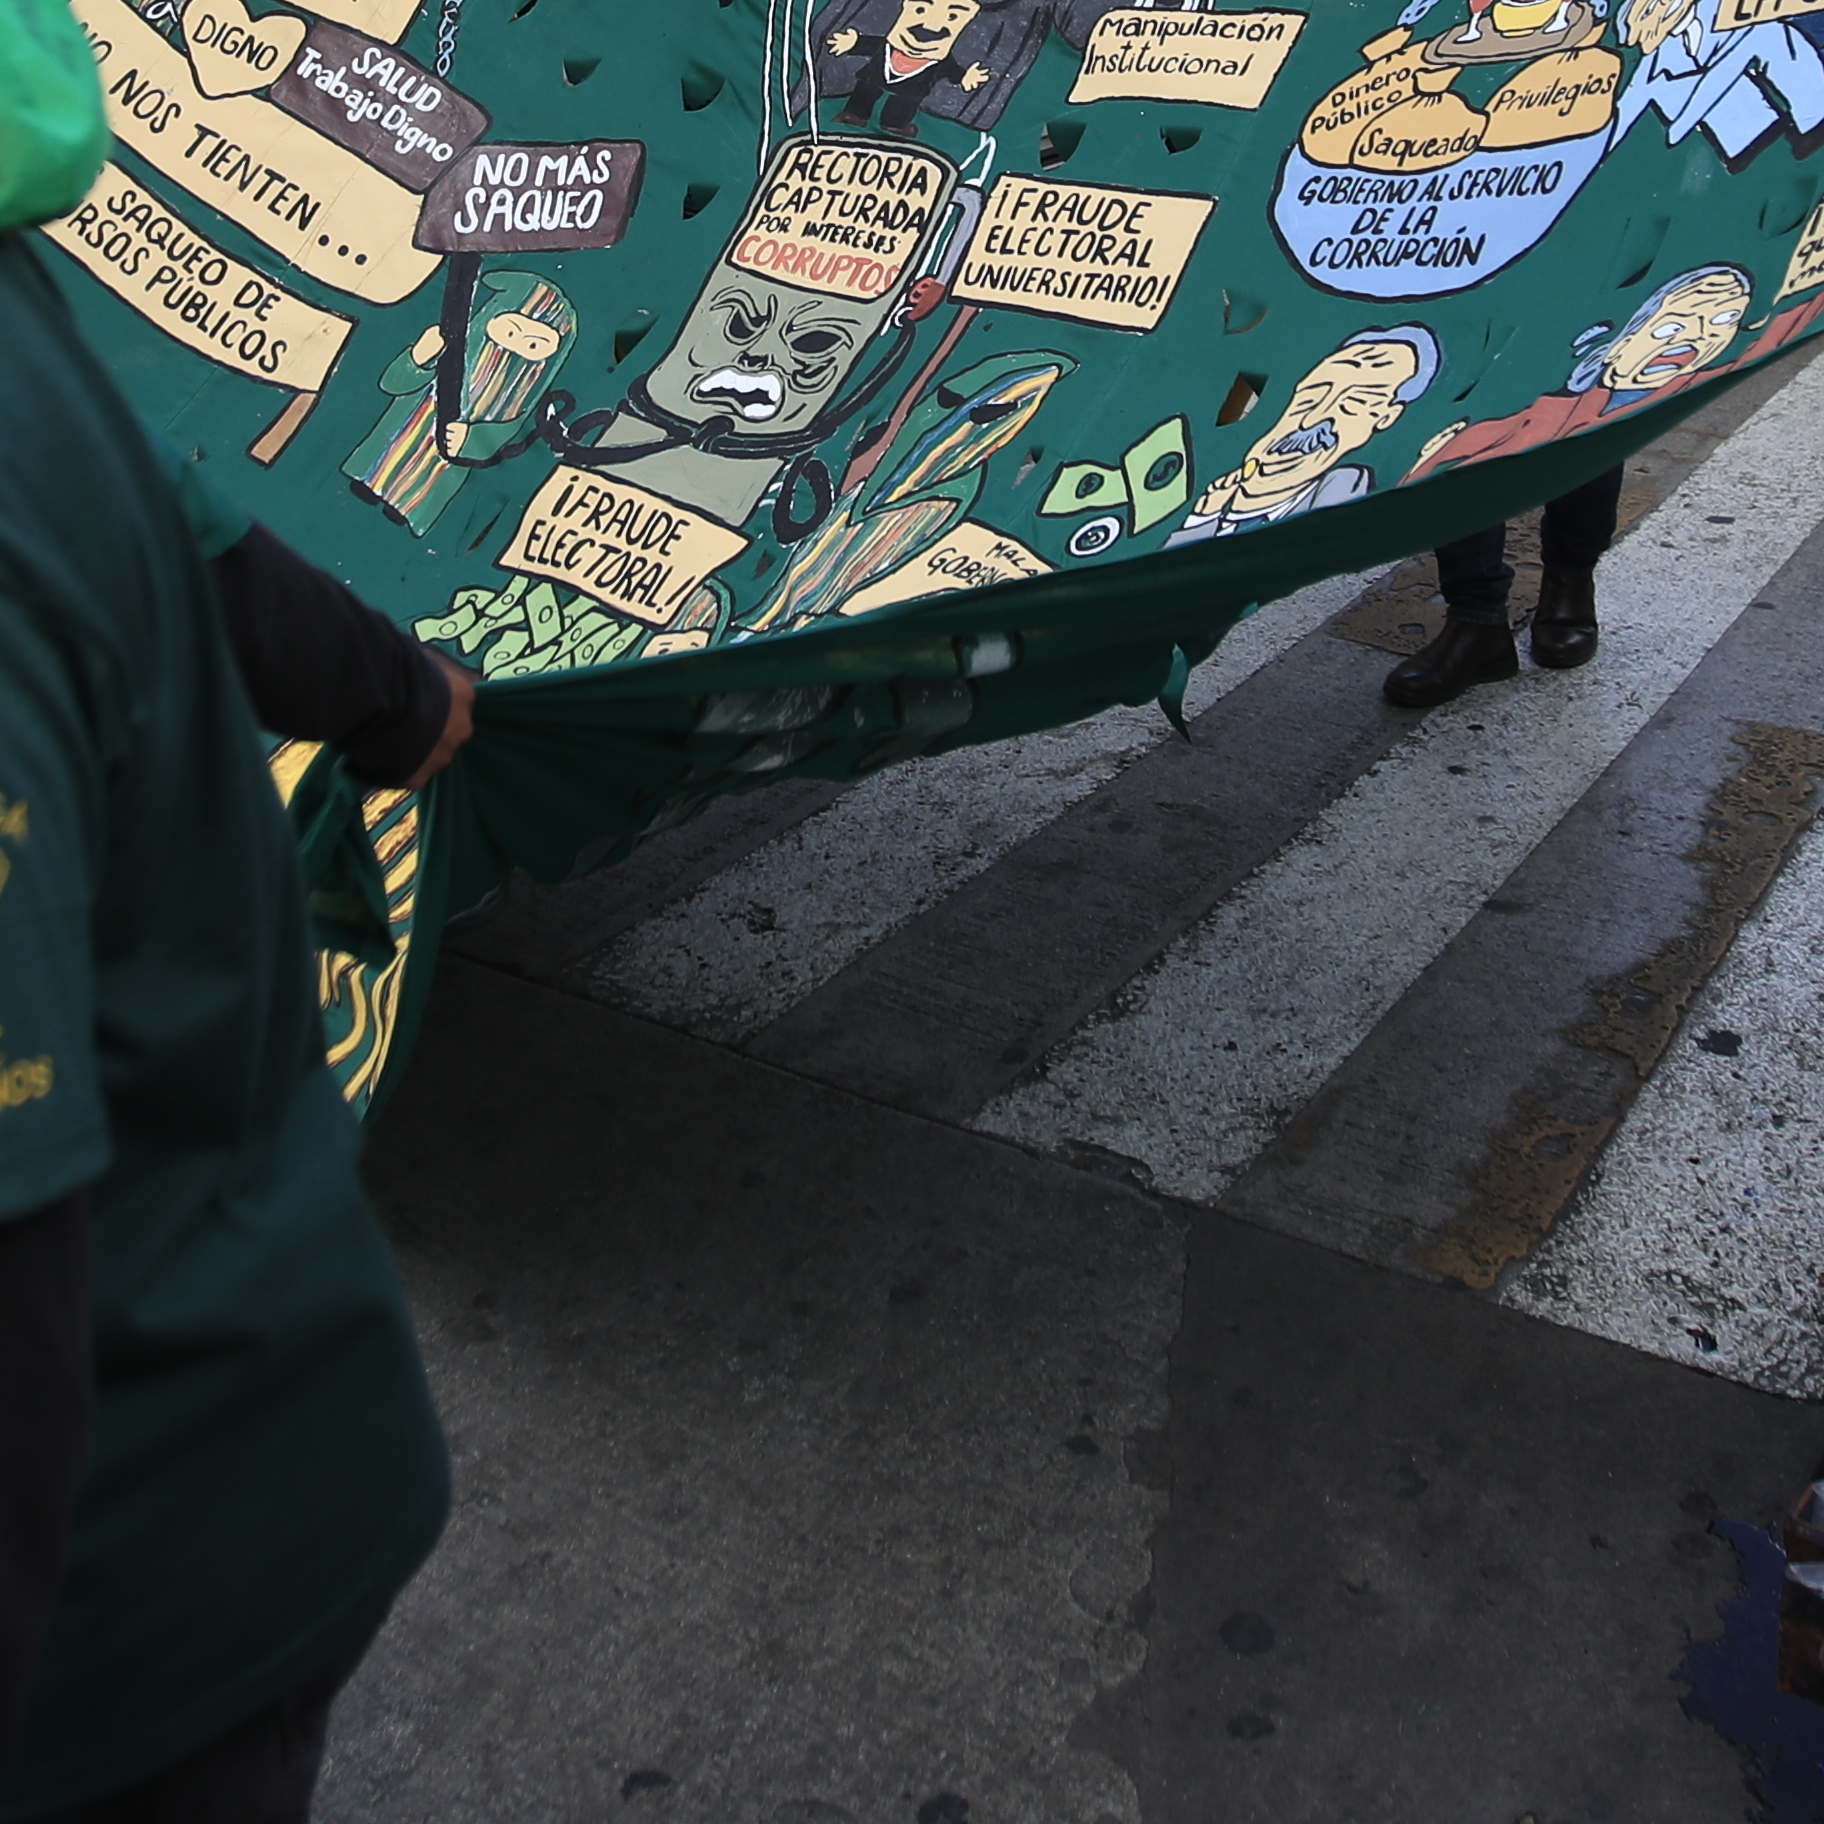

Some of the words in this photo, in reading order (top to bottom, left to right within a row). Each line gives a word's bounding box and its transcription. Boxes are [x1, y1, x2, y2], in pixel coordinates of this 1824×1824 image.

[192, 14, 279, 72] DIGNO
[1098, 13, 1286, 47] Manipulación
[351, 46, 443, 113] SALUD
[1083, 39, 1256, 76] Institucional
[108, 68, 182, 134] NOS
[296, 46, 383, 123] Trabajo
[380, 104, 454, 162] Digno
[1330, 67, 1411, 108] Dinero
[1491, 72, 1617, 117] Privilegios
[1309, 89, 1402, 135] Público
[473, 152, 530, 188] NO
[534, 145, 612, 188] MÁS
[1357, 127, 1479, 167] Saqueado
[1297, 174, 1420, 206] GOBIERNO
[1416, 174, 1449, 204] AL
[1448, 160, 1564, 202] SERVICIO
[454, 186, 605, 234] SAQUEO
[763, 181, 927, 236] CAPTURADA
[994, 182, 1153, 235] ¡FRAUDE
[1349, 206, 1394, 236] DE
[1397, 205, 1439, 236] LA
[107, 189, 228, 287] SAQUEO
[232, 279, 282, 322] DE
[753, 213, 792, 235] POR
[800, 221, 897, 255] INTERESES
[984, 224, 1154, 269] ELECTORAL
[1308, 226, 1487, 269] CORRUPCIÓN
[736, 234, 902, 297] CORRUPTOS
[962, 261, 1172, 311] UNIVERSITARIO!
[144, 265, 288, 375] PÚBLICOS
[550, 474, 692, 557] ¡FRAUDE
[522, 519, 697, 615] ELECTORAL!
